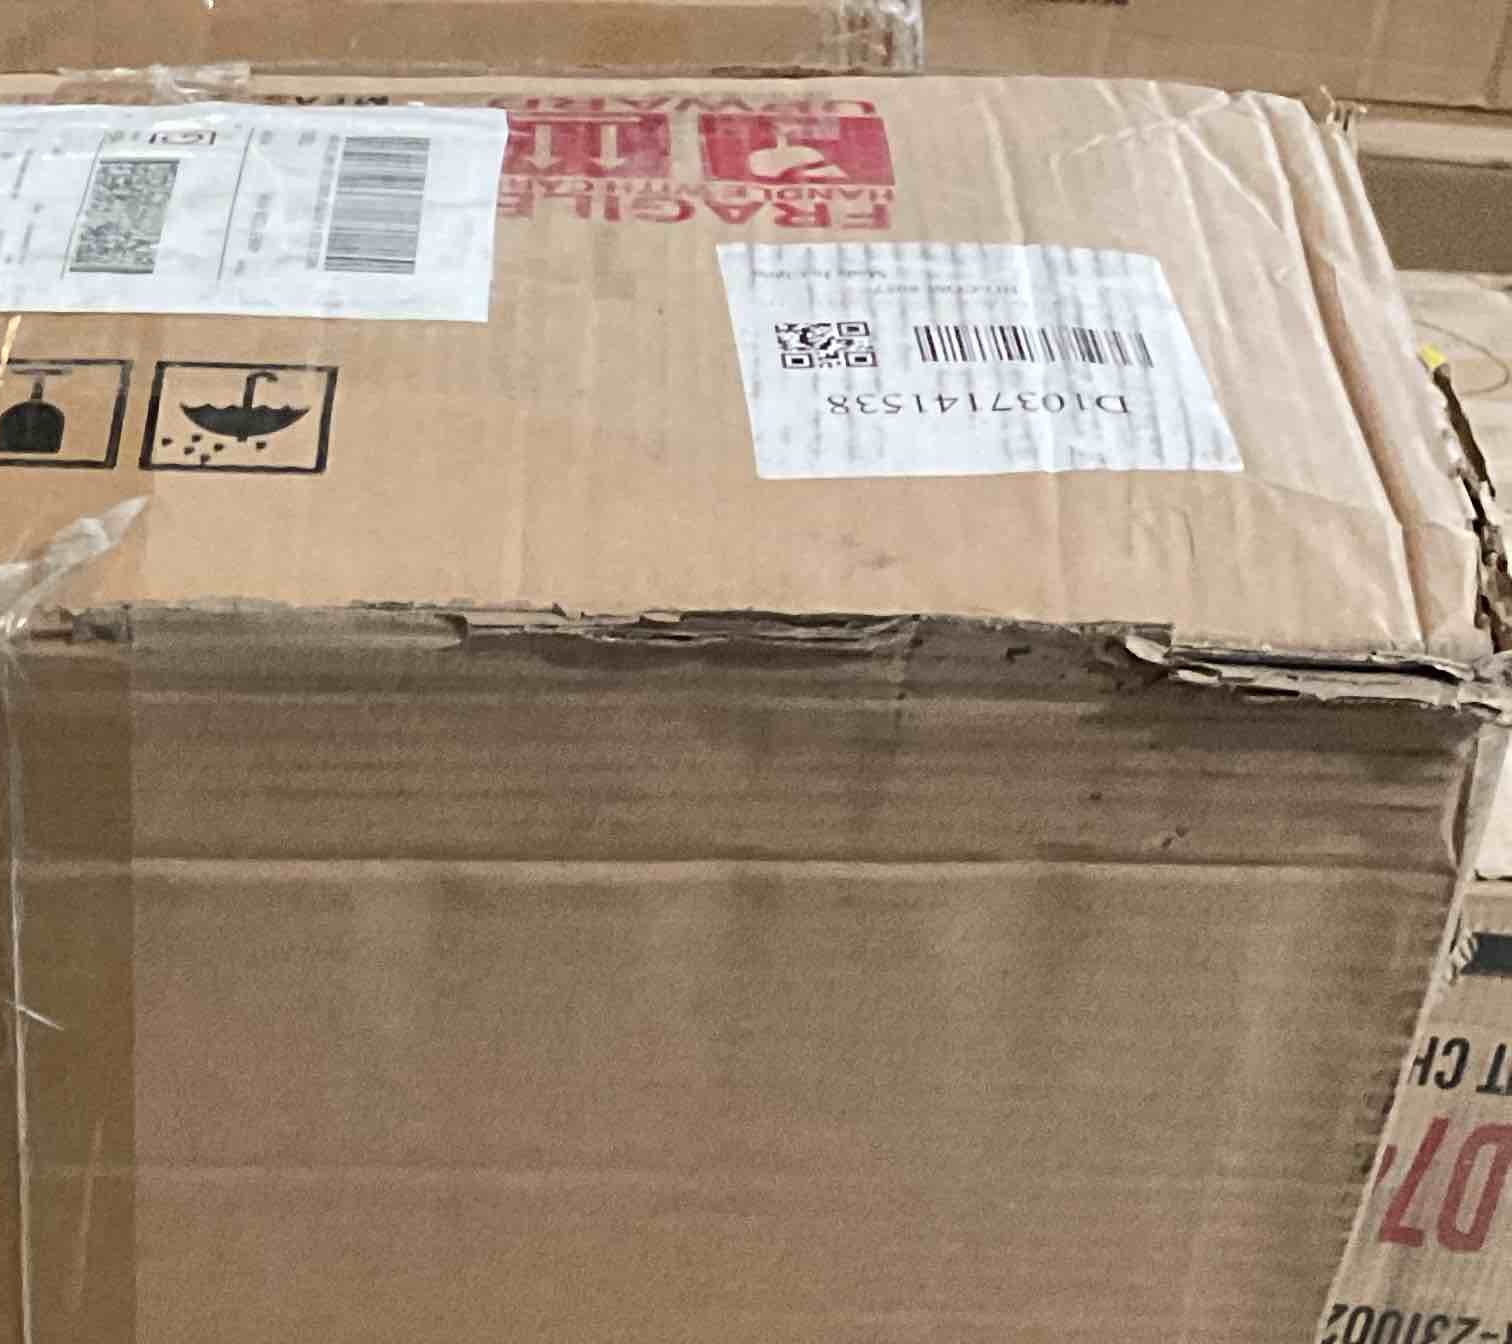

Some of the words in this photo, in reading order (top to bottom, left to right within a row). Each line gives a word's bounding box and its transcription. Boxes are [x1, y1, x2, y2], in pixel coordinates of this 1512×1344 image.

[489, 96, 876, 114] UPWARD
[498, 178, 594, 194] CAR
[720, 186, 894, 202] HANDLE
[496, 192, 892, 232] FRAGILE
[824, 392, 1130, 415] D1037141538
